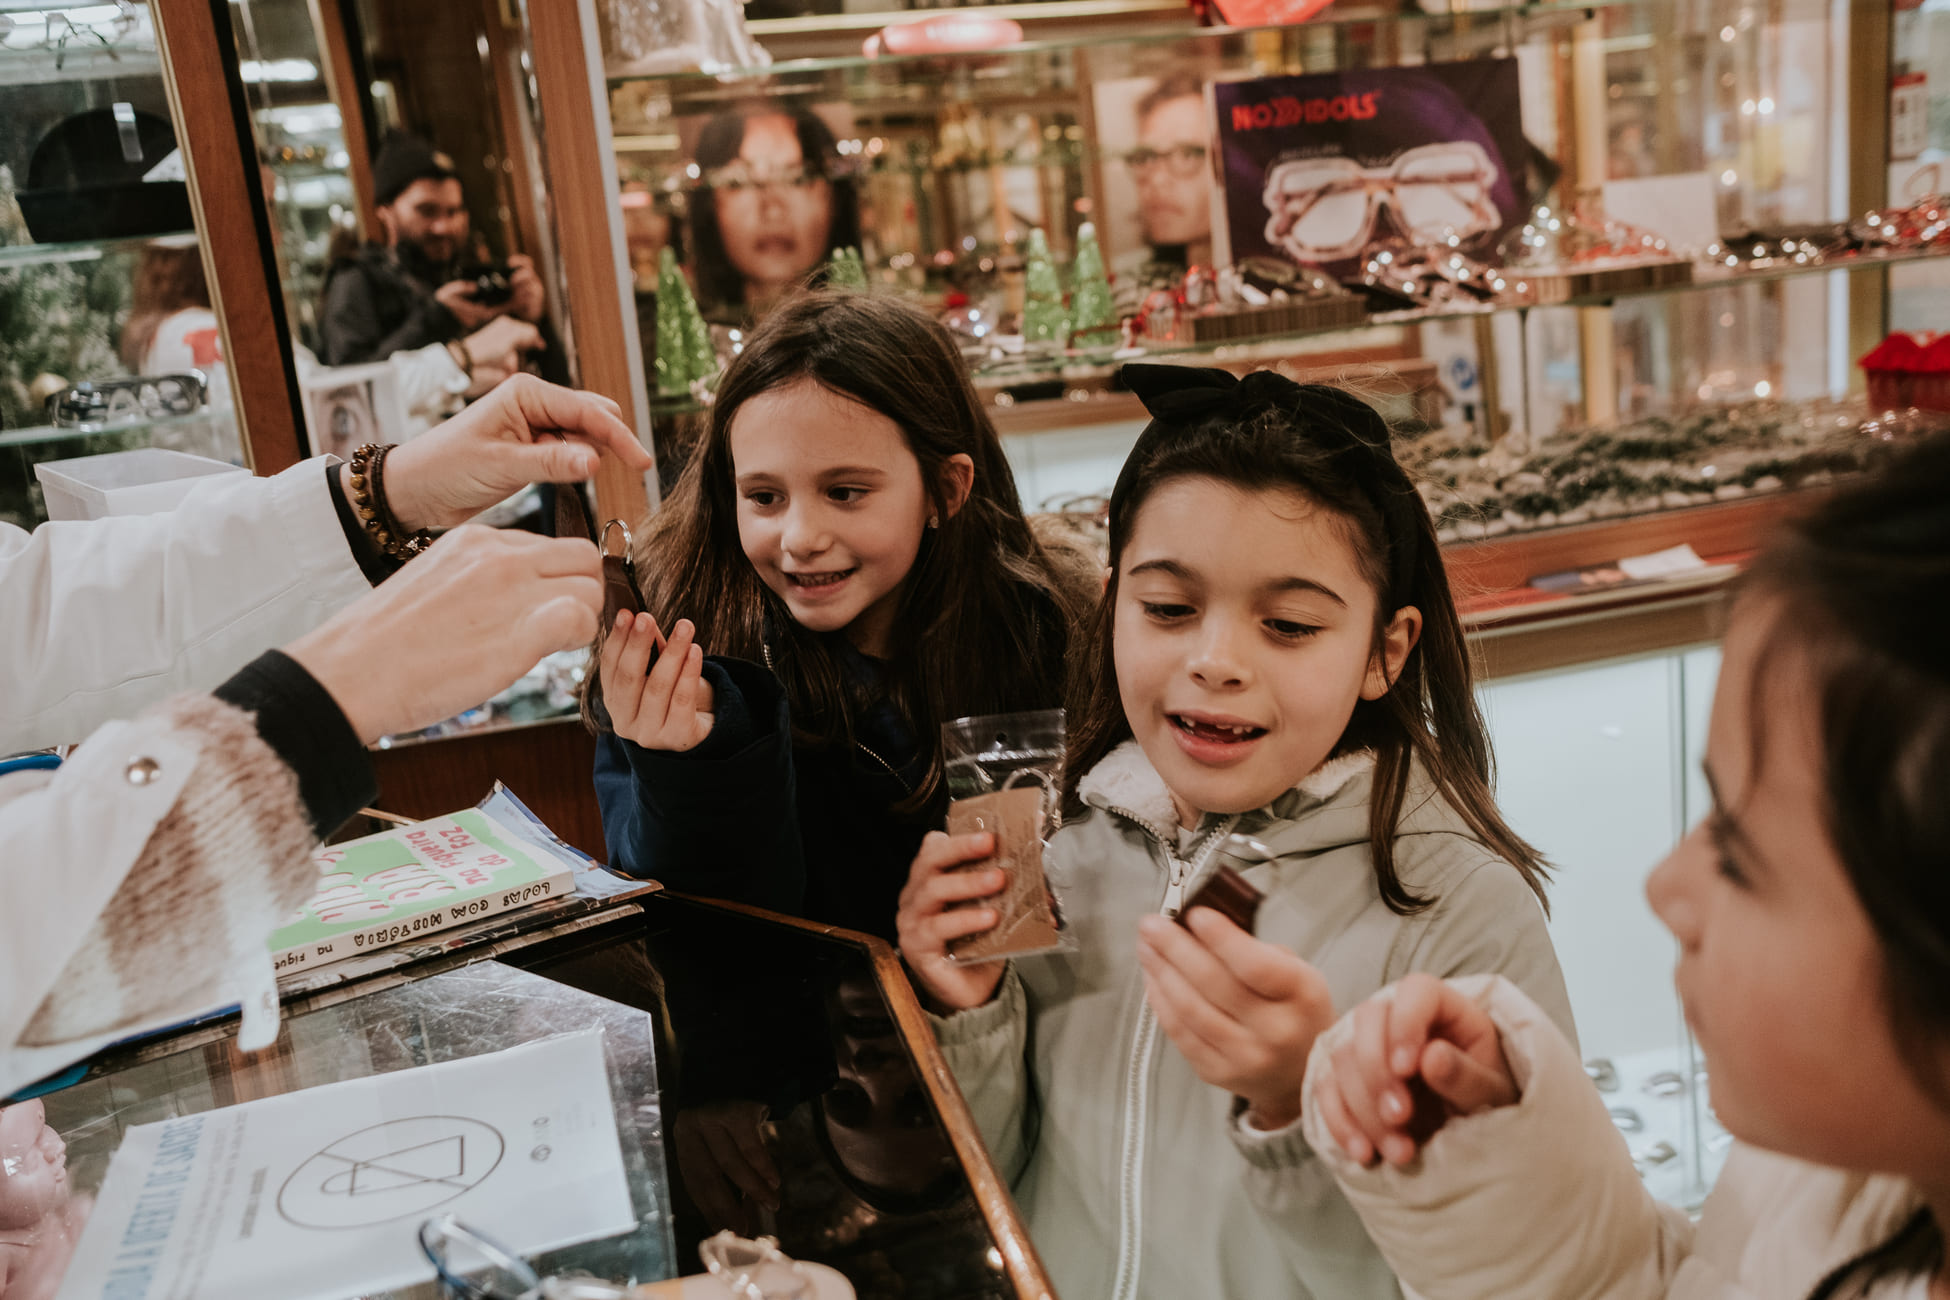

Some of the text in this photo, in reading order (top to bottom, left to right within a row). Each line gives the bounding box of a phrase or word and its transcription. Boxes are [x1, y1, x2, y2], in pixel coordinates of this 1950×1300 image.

[477, 854, 508, 866] da
[458, 868, 489, 885] na
[503, 882, 550, 907] LOJAS
[451, 899, 489, 919] COM
[354, 913, 442, 947] HISTÓRIA
[317, 944, 333, 956] na
